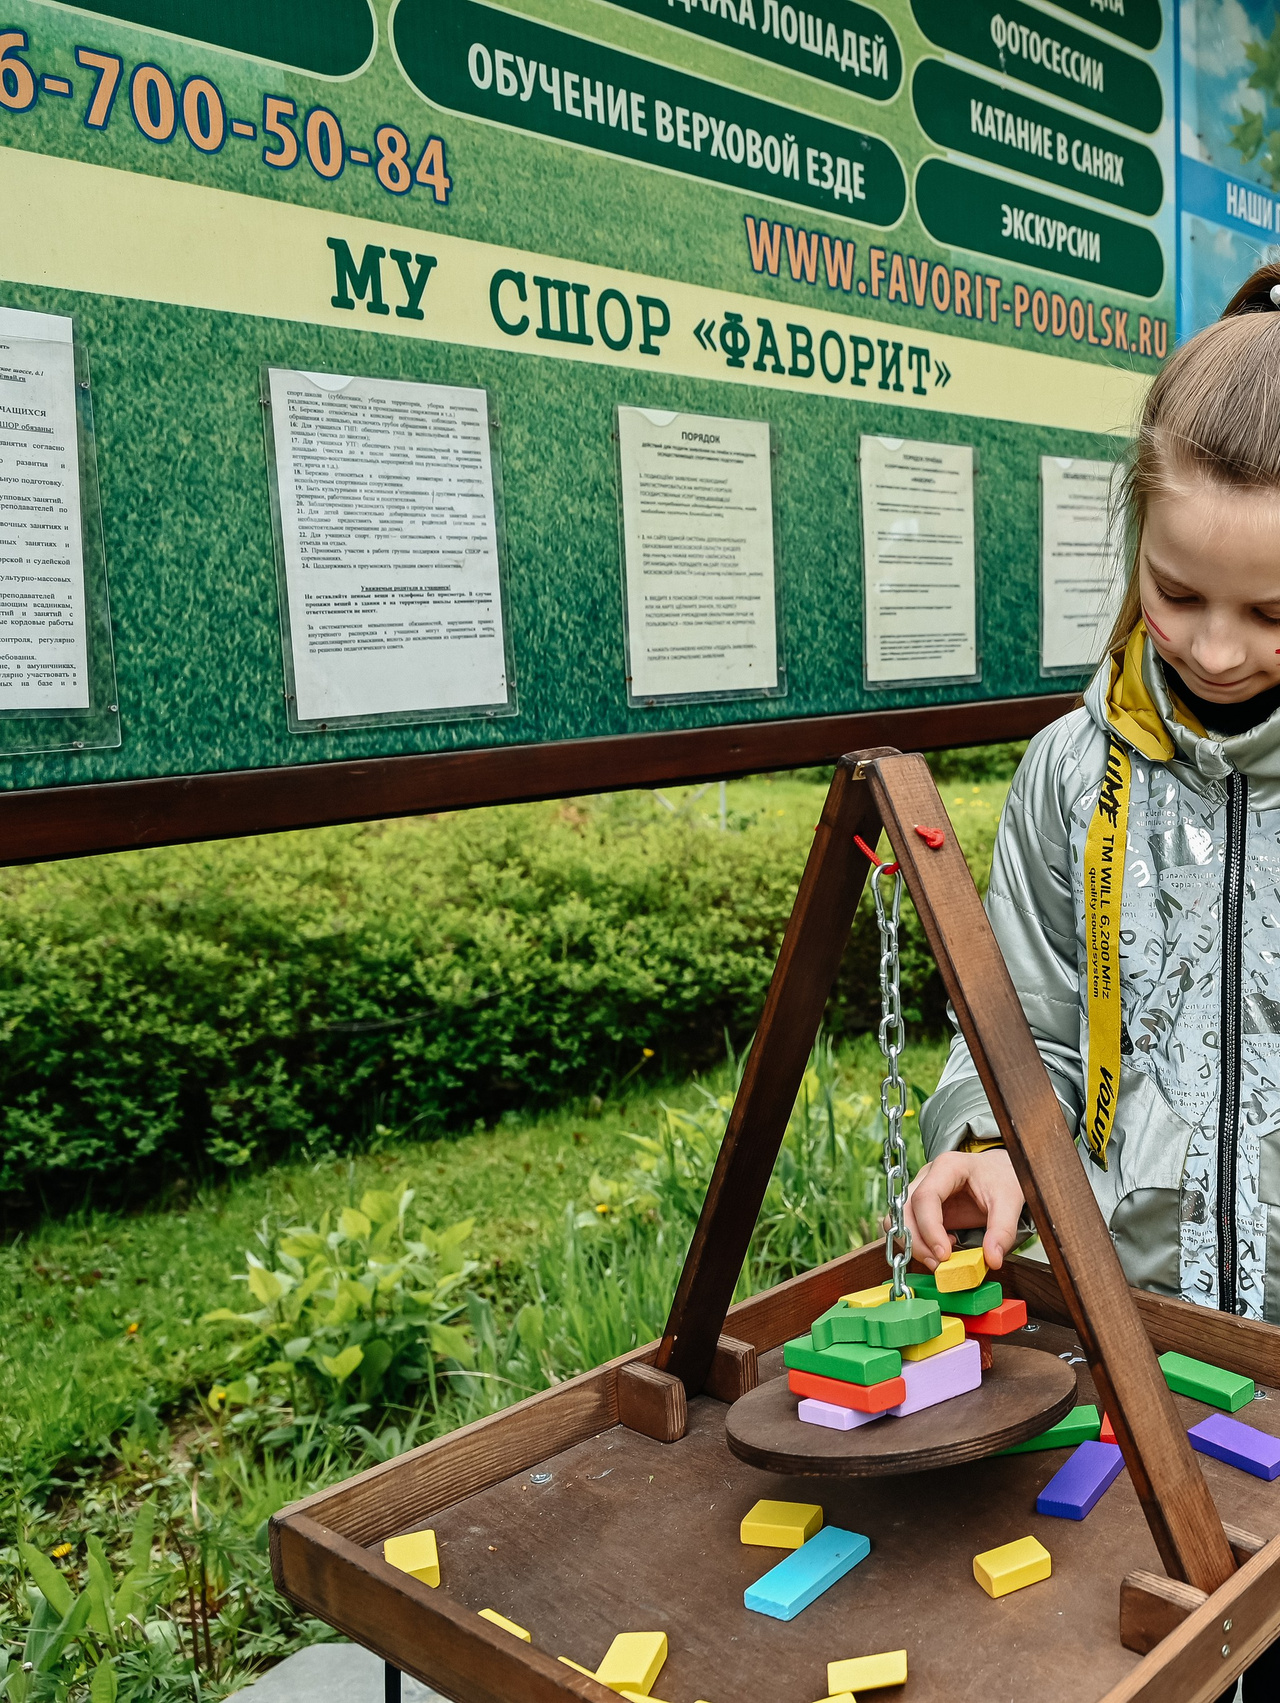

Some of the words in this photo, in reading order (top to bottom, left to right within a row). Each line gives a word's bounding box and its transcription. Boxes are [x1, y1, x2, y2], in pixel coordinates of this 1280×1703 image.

[761, 0, 888, 81] ЛОШАДЕЙ
[990, 13, 1104, 93] ФОТОСЕССИИ
[0, 28, 452, 204] 6-700-50-84
[467, 42, 648, 137] ОБУЧЕНИЕ
[655, 99, 799, 182] ВЕРХОВОЙ
[806, 150, 866, 203] ЕЗДЕ
[970, 99, 1054, 161] КАТАНИЕ
[1056, 135, 1069, 167] В
[1071, 138, 1125, 188] САНЯХ
[1001, 203, 1101, 263] ЭКСКУРСИИ
[1226, 181, 1272, 230] НАШИ
[326, 236, 438, 321] МУ
[489, 268, 671, 356] СШОР
[692, 311, 952, 396] «ФАВОРИТ»
[744, 214, 1169, 360] WWW.FAVORIT-PODOLSK.RU
[32, 444, 64, 452] согласно
[1102, 834, 1114, 862] TM
[1089, 868, 1097, 911] quality
[1100, 868, 1113, 908] WILL
[1090, 912, 1098, 951] sound
[1099, 914, 1111, 961] 6,200
